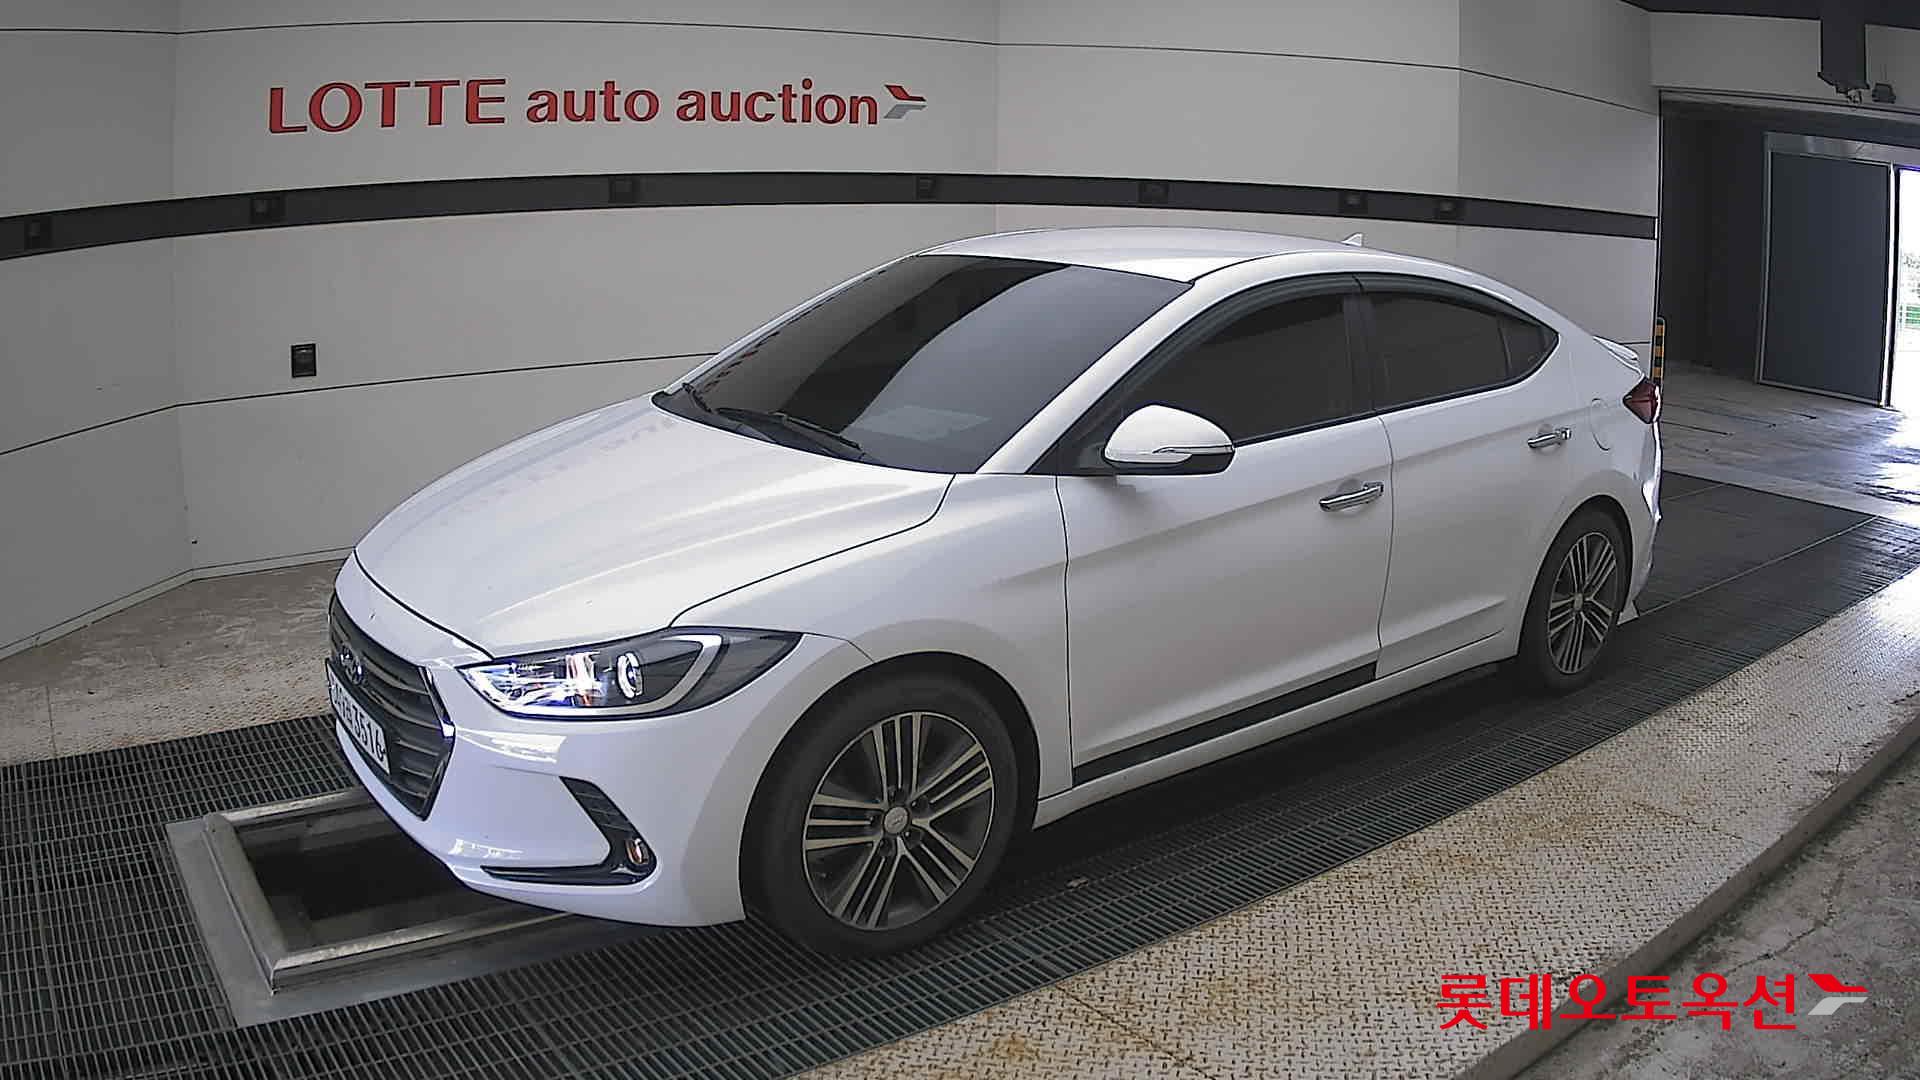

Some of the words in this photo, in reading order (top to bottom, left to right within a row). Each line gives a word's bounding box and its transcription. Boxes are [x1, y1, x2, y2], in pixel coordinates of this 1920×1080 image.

[268, 78, 505, 133] LOTTE
[526, 80, 660, 124] auto
[675, 78, 880, 125] auction
